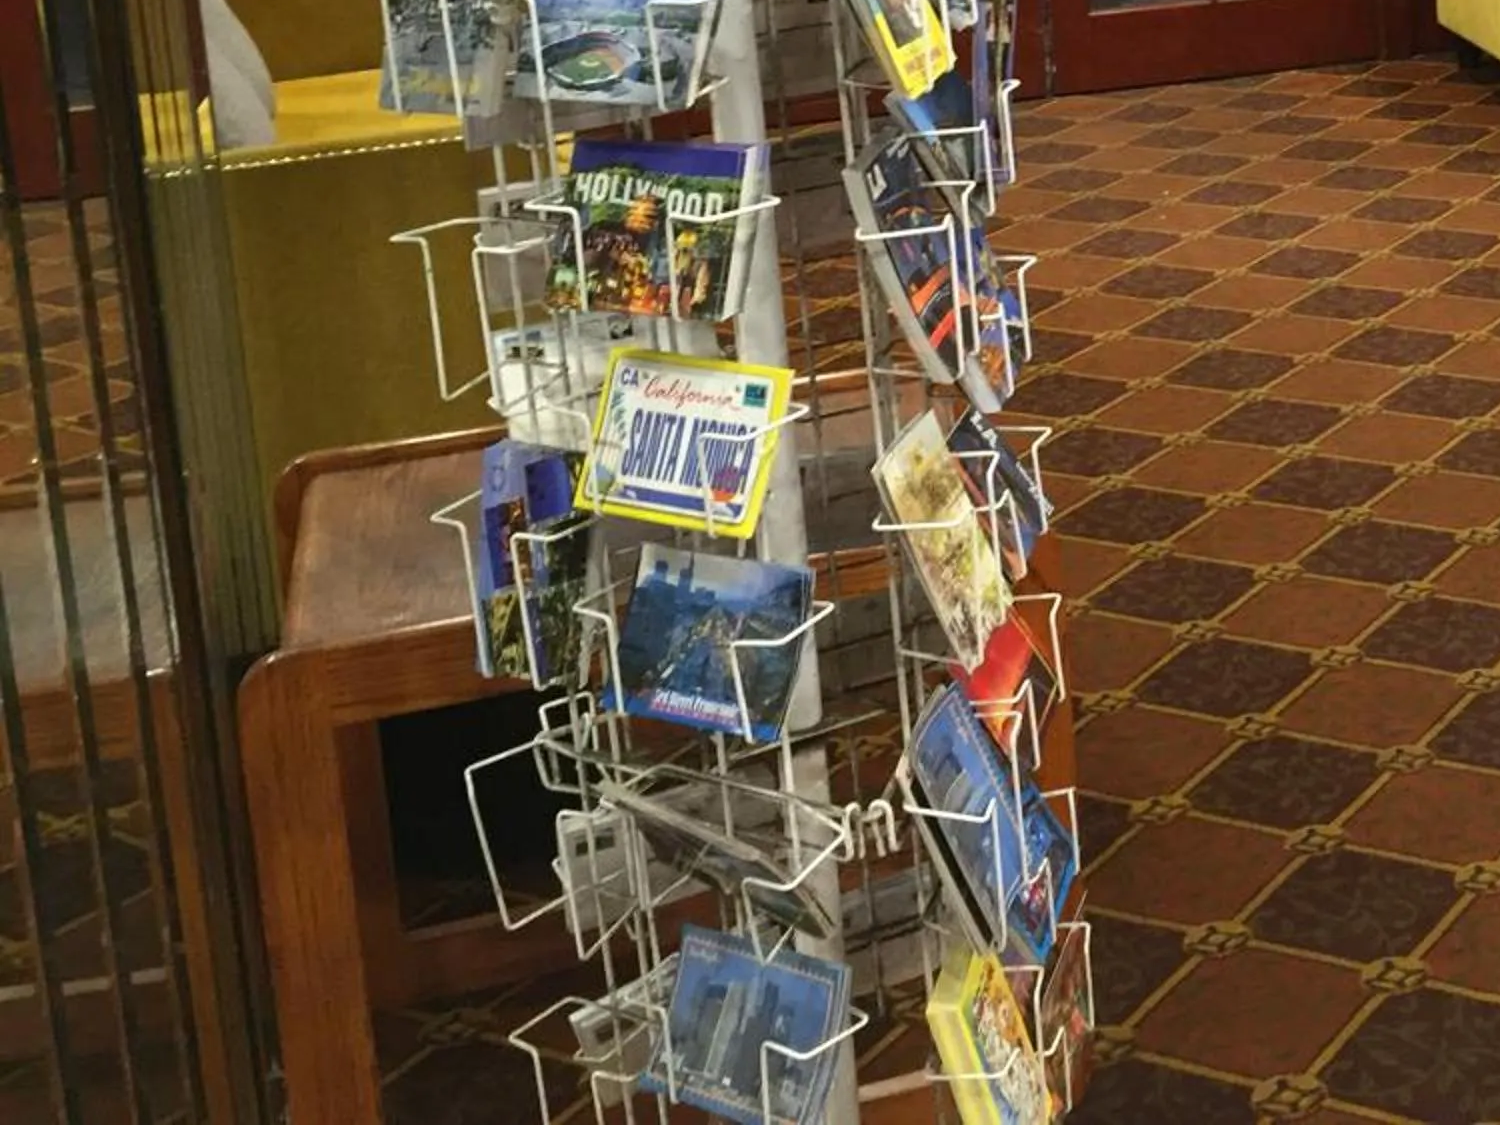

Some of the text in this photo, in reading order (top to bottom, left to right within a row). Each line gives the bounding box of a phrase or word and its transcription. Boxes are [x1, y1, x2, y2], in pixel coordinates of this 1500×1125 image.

[574, 172, 725, 219] HOLLYWOOD
[621, 366, 640, 388] CA
[643, 376, 742, 411] California
[621, 408, 758, 496] SANTA MONICA
